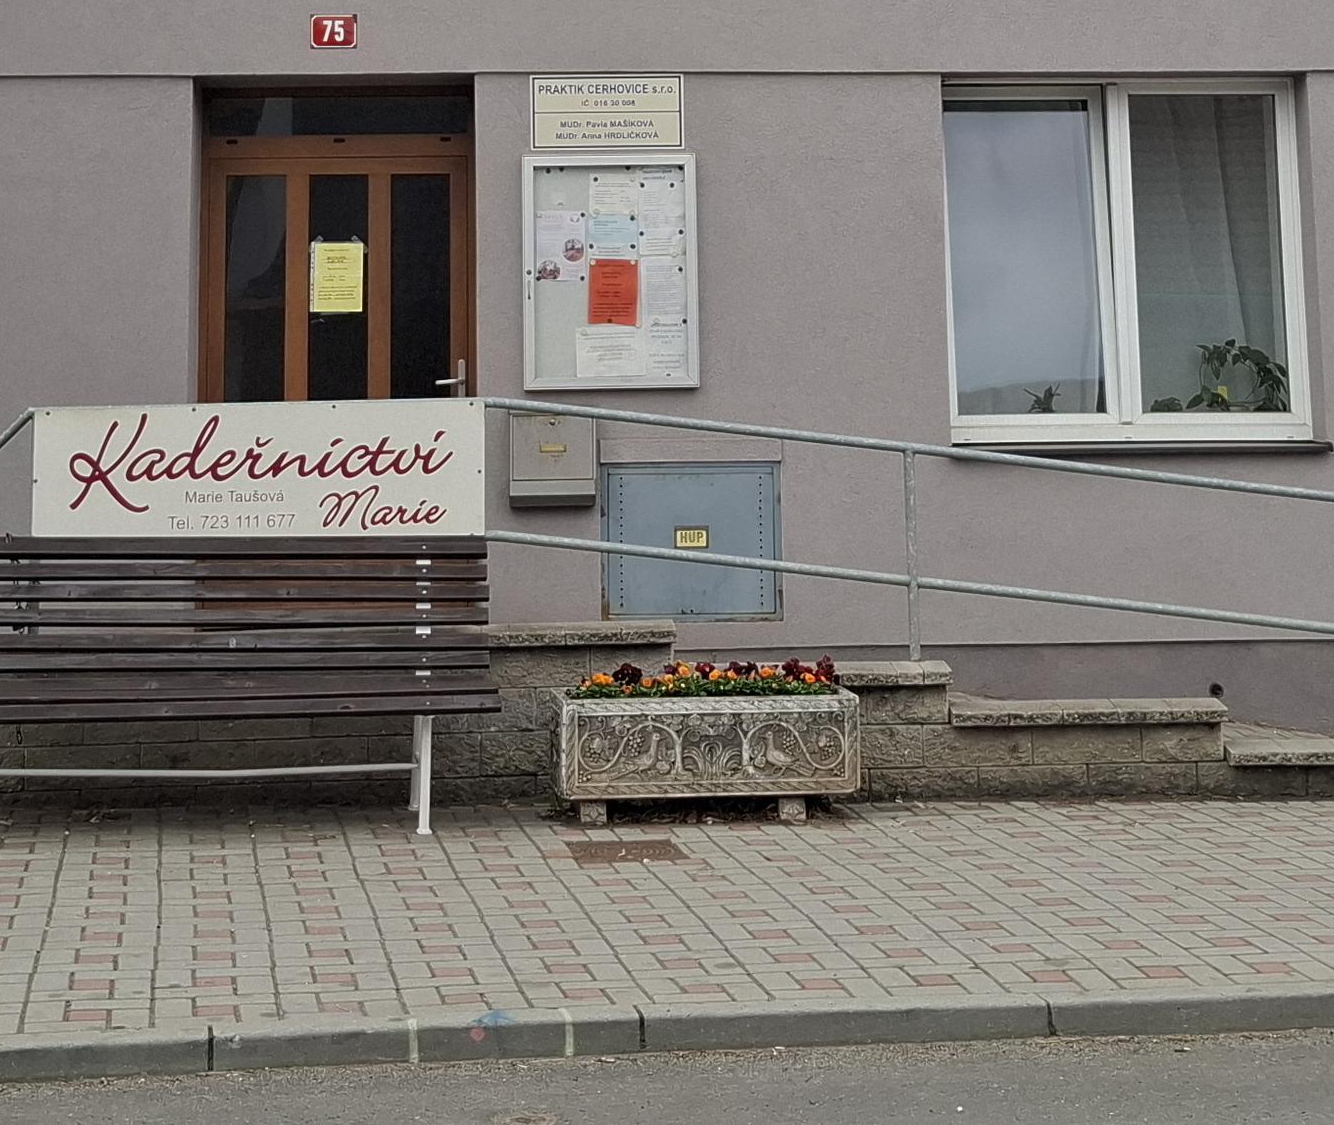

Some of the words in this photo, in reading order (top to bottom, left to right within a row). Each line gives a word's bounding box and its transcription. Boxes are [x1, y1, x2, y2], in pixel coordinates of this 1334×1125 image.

[322, 20, 345, 42] 75
[538, 84, 585, 95] PRAKTIK
[587, 83, 649, 94] CERHOVICE
[652, 85, 676, 94] s.r.o.
[555, 132, 579, 140] MUDr.
[604, 130, 660, 139] HRDLIČKOVÁ
[69, 412, 454, 513] Kadeřnictví
[184, 490, 223, 503] Marie
[227, 489, 284, 503] Taušová
[319, 484, 447, 530] Marie
[167, 516, 194, 530] Tel.
[200, 515, 229, 529] 723
[235, 515, 260, 528] 111
[266, 514, 295, 528] 677
[680, 531, 703, 543] HUP
